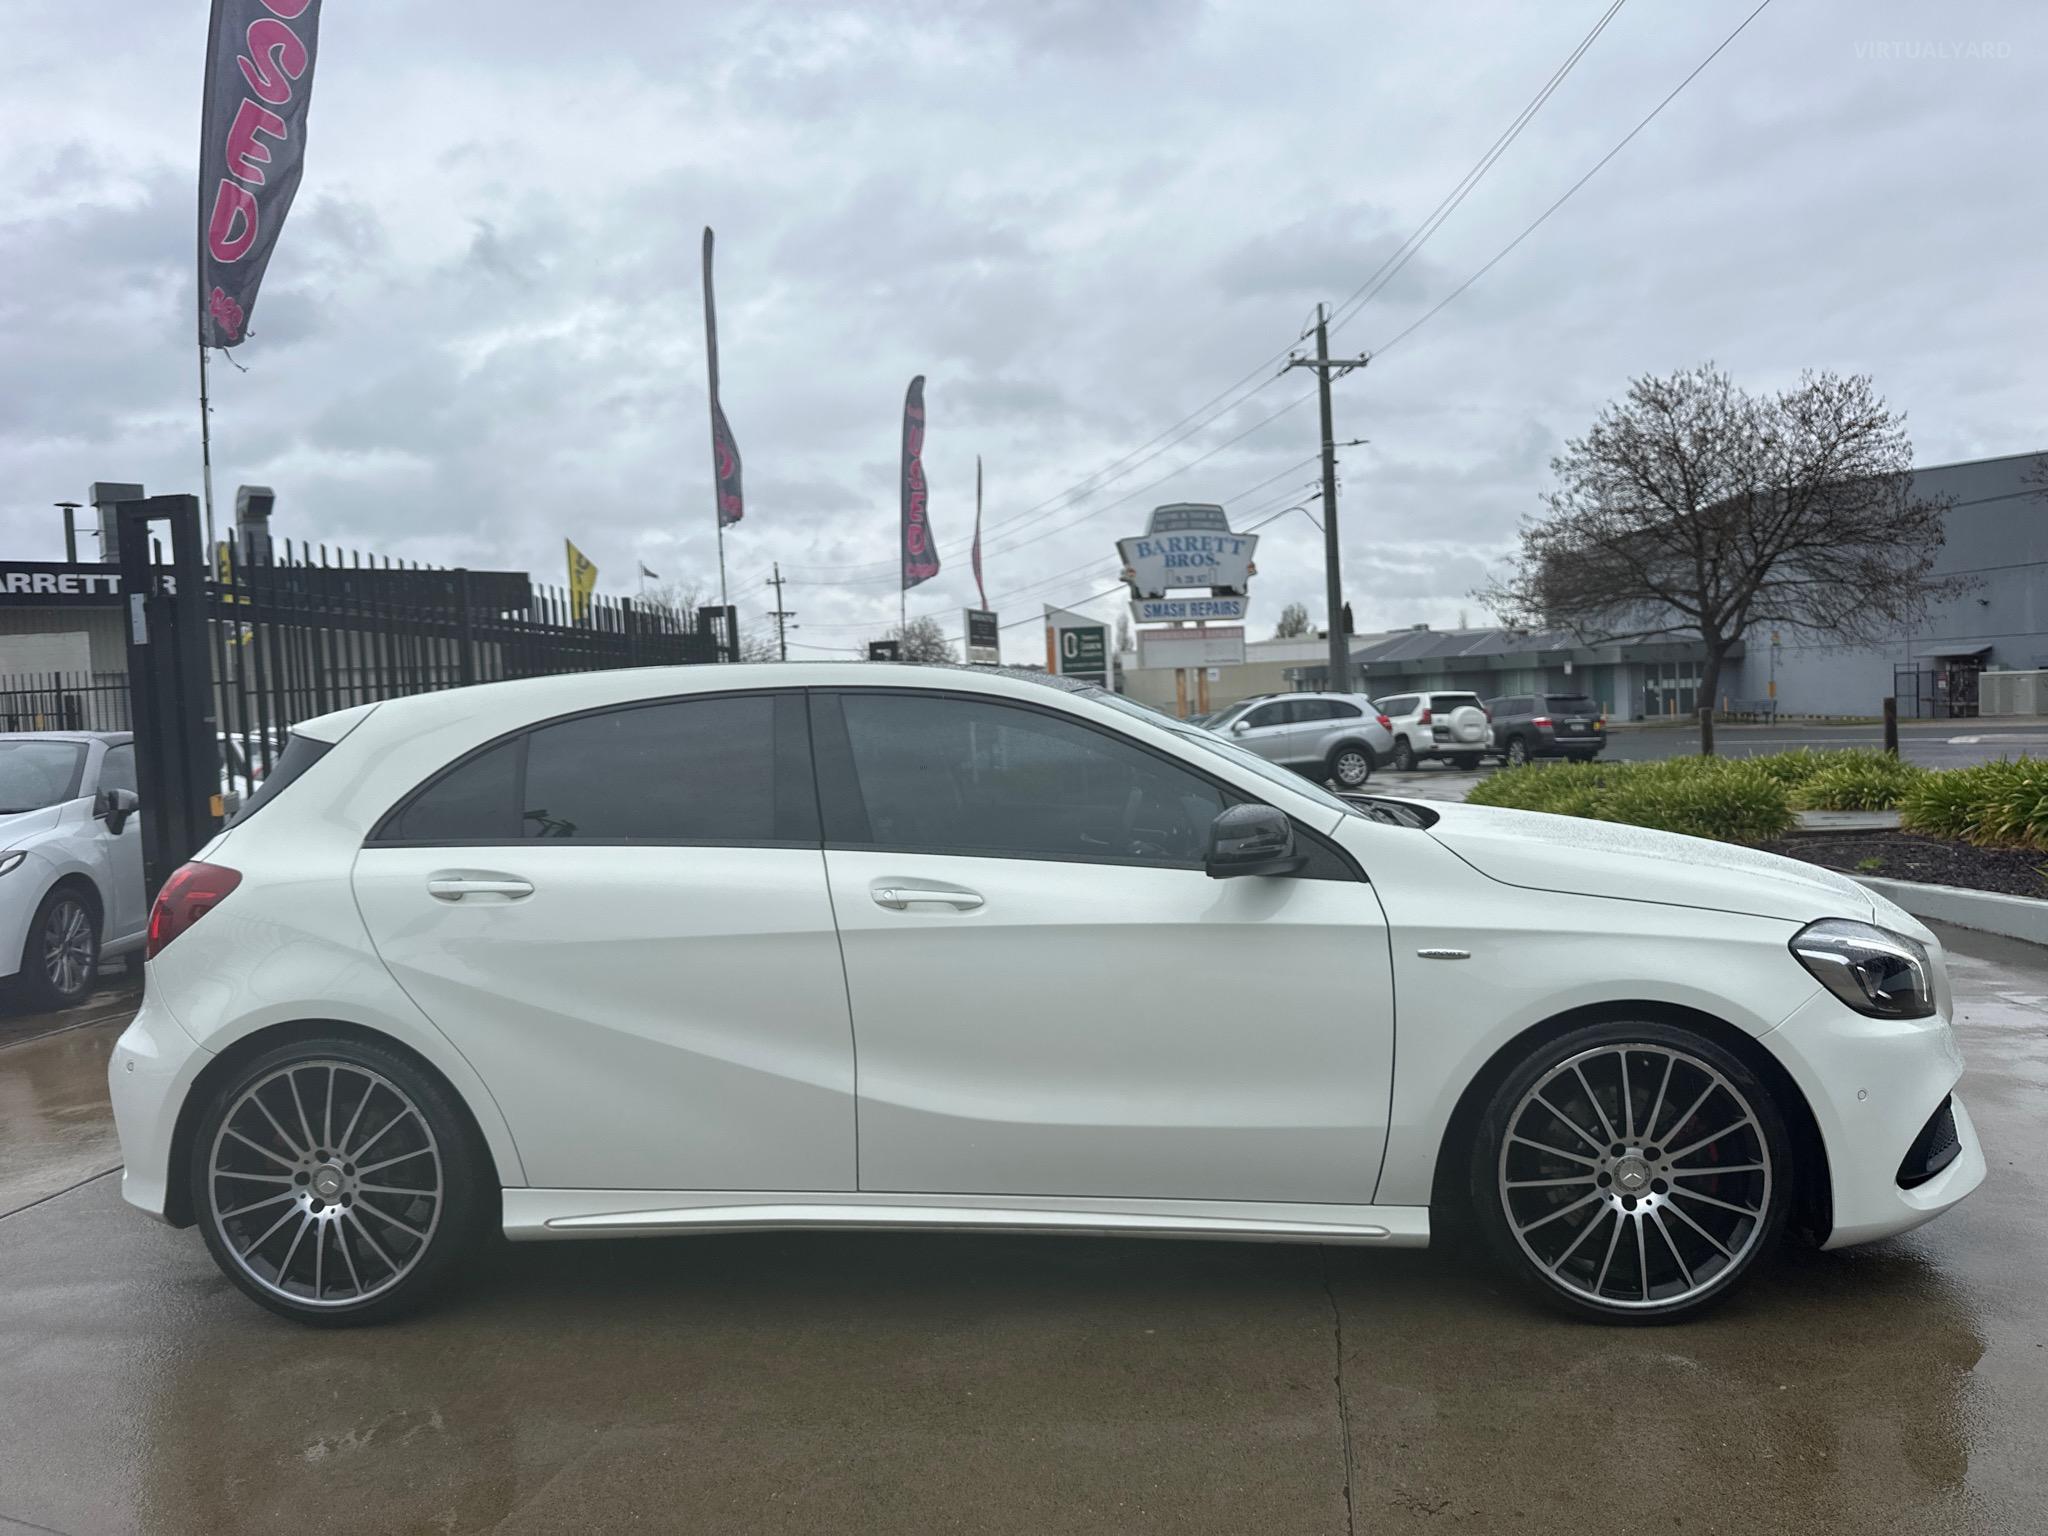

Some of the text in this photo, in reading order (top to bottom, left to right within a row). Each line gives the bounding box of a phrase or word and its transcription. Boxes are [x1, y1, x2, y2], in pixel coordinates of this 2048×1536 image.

[208, 0, 313, 263] SED
[1136, 535, 1247, 559] BARRETT
[1143, 601, 1240, 618] SMASH REPAIRS
